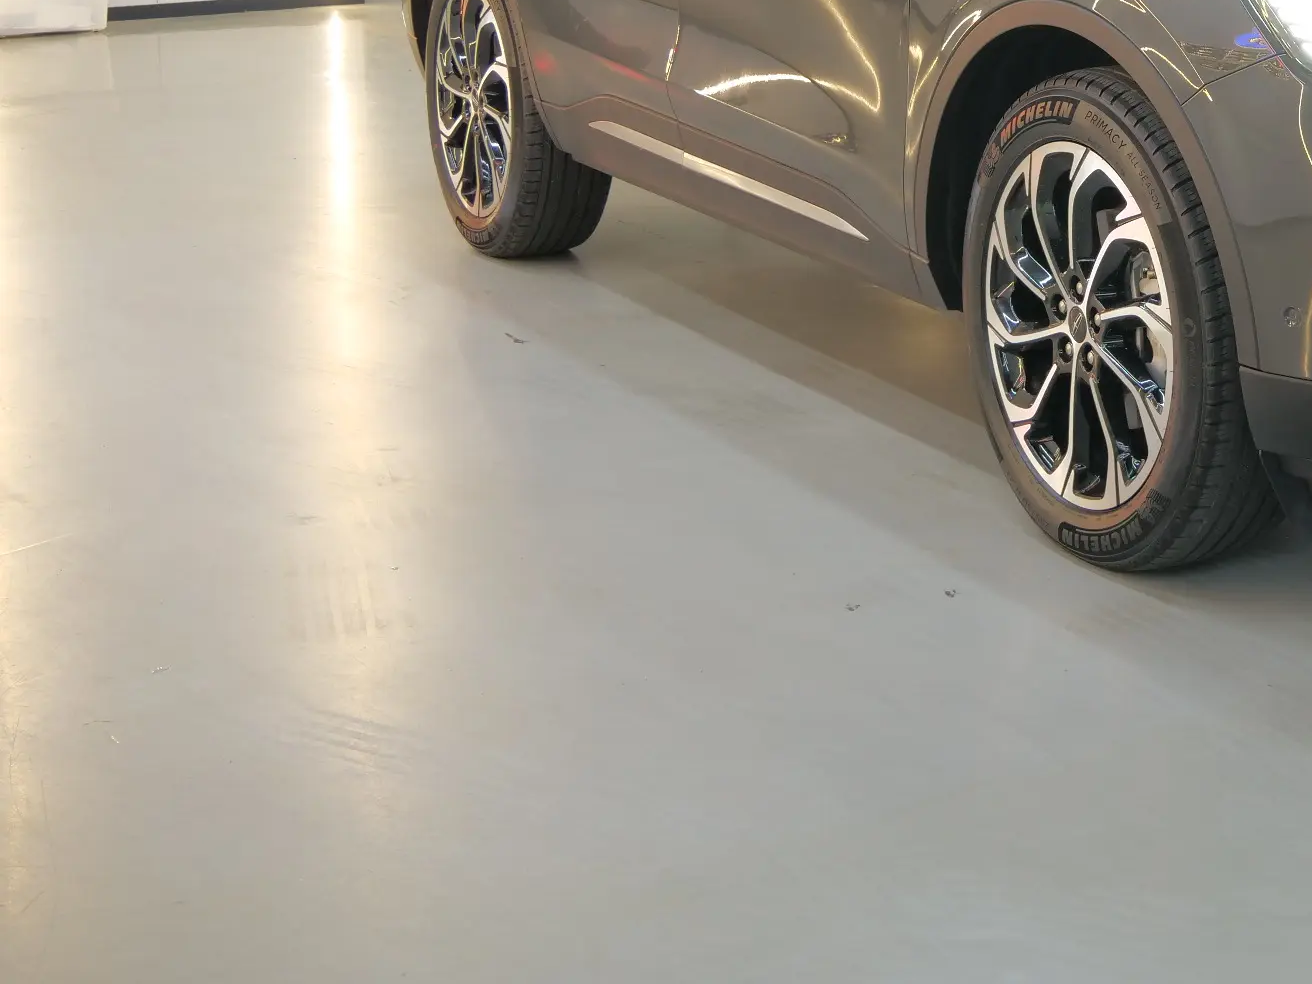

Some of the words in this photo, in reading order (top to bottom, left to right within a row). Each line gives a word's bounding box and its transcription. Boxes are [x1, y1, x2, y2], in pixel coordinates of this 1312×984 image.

[1000, 100, 1074, 146] MICHELIN
[1084, 110, 1127, 152] PRIMACY
[1126, 149, 1144, 168] ALL
[1138, 168, 1163, 211] SEASON
[1061, 518, 1143, 552] MICHELIN
